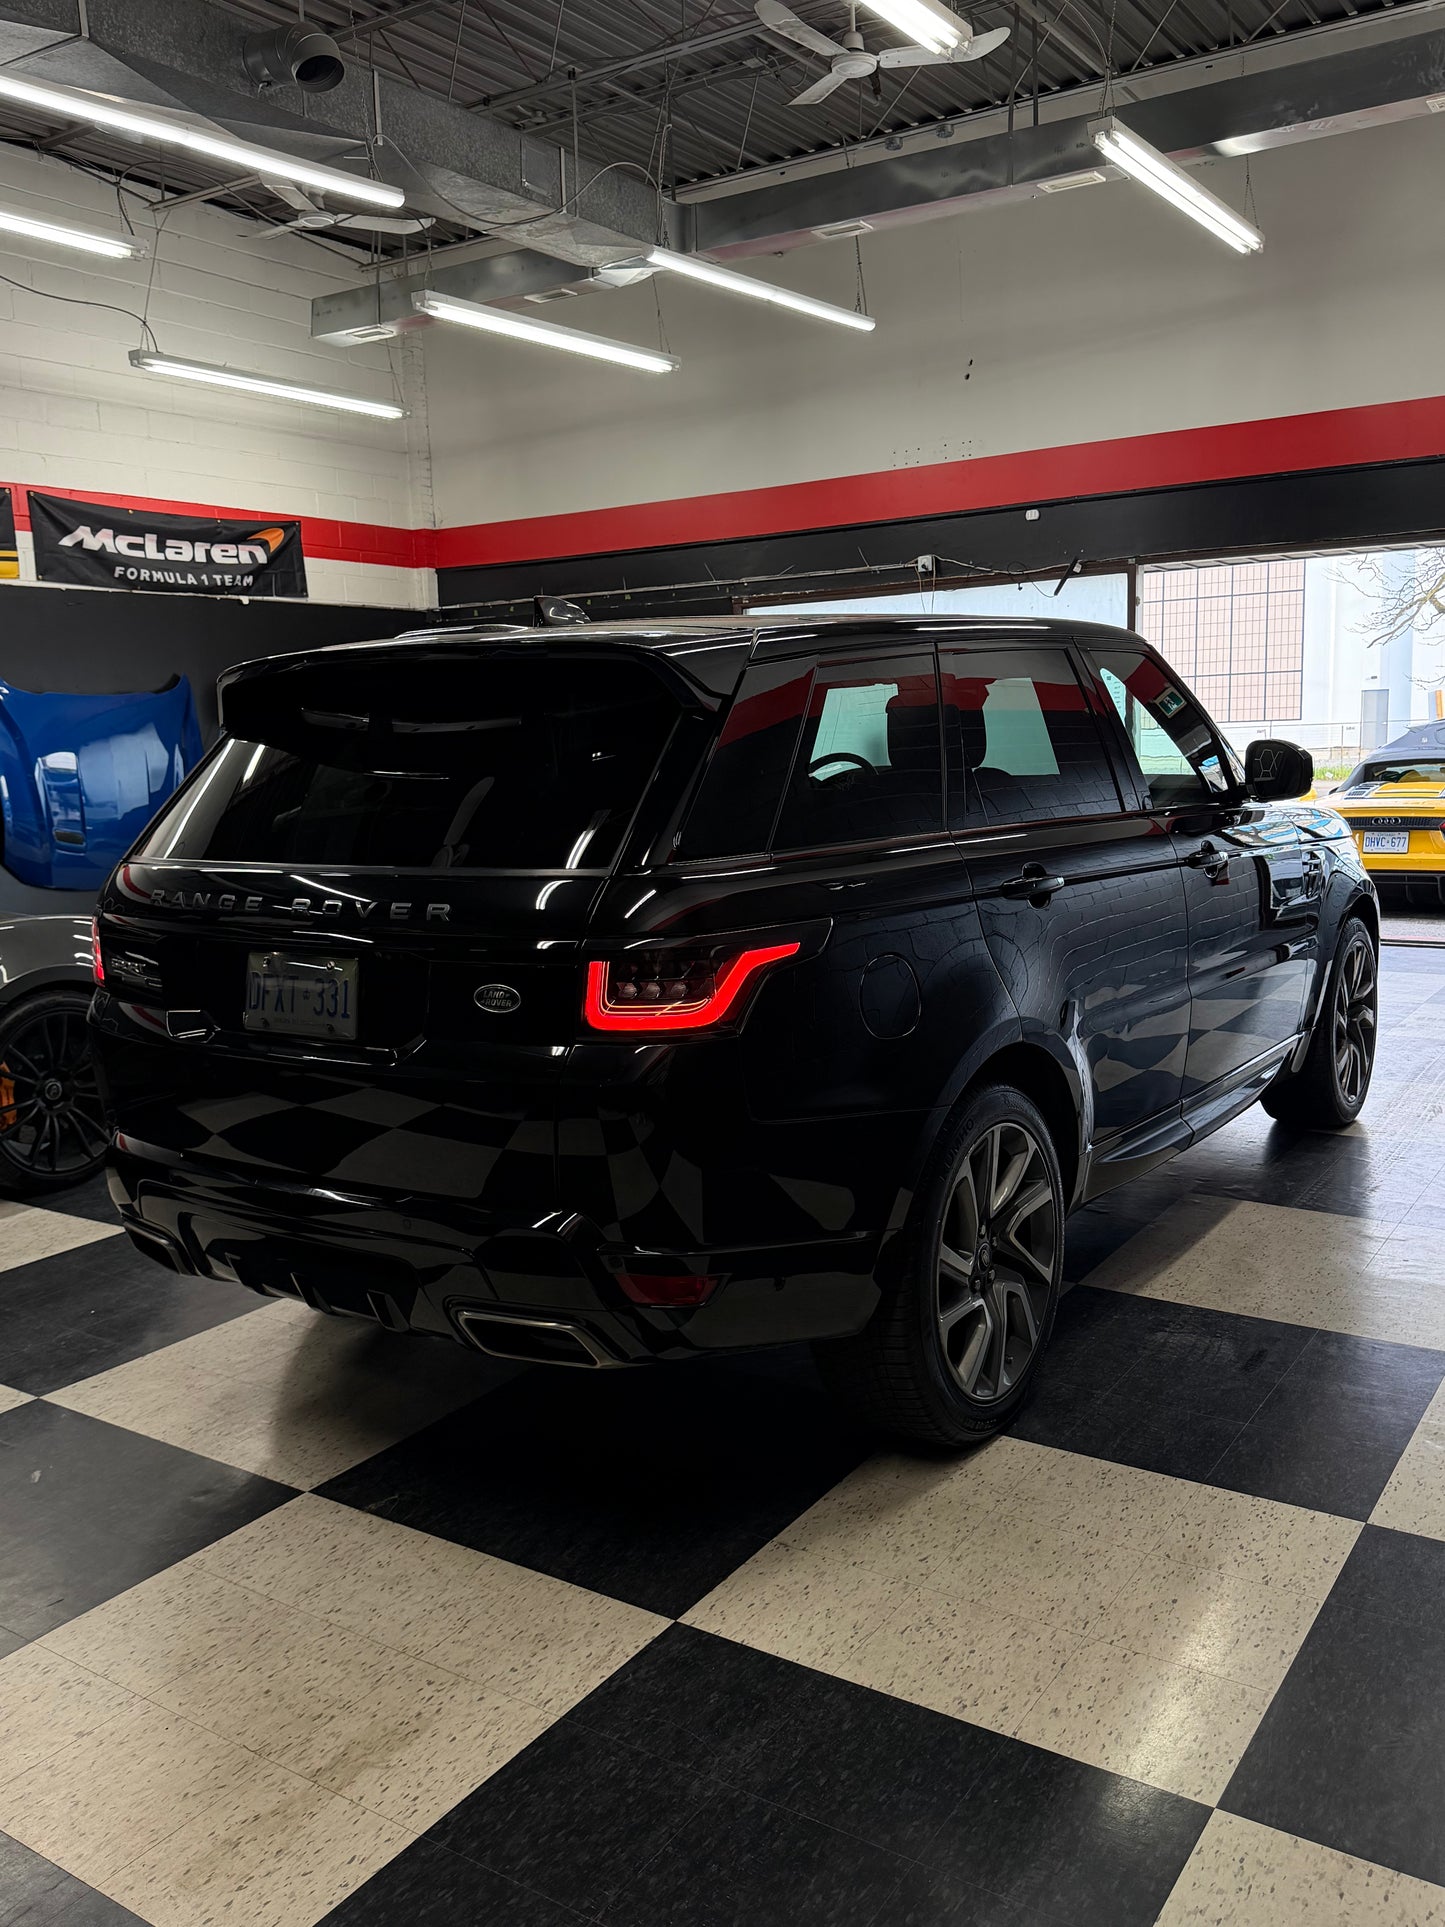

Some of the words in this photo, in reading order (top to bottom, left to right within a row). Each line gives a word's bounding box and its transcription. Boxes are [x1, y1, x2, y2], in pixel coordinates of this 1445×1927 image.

[58, 525, 267, 565] McLaren
[114, 566, 196, 586] FORMULA
[201, 574, 208, 586] 1
[213, 574, 254, 587] TEAM
[1390, 836, 1406, 847] 677
[150, 889, 264, 912] RANGE
[291, 897, 452, 922] ROVER
[483, 990, 505, 999] LAND
[485, 998, 512, 1007] ROVER
